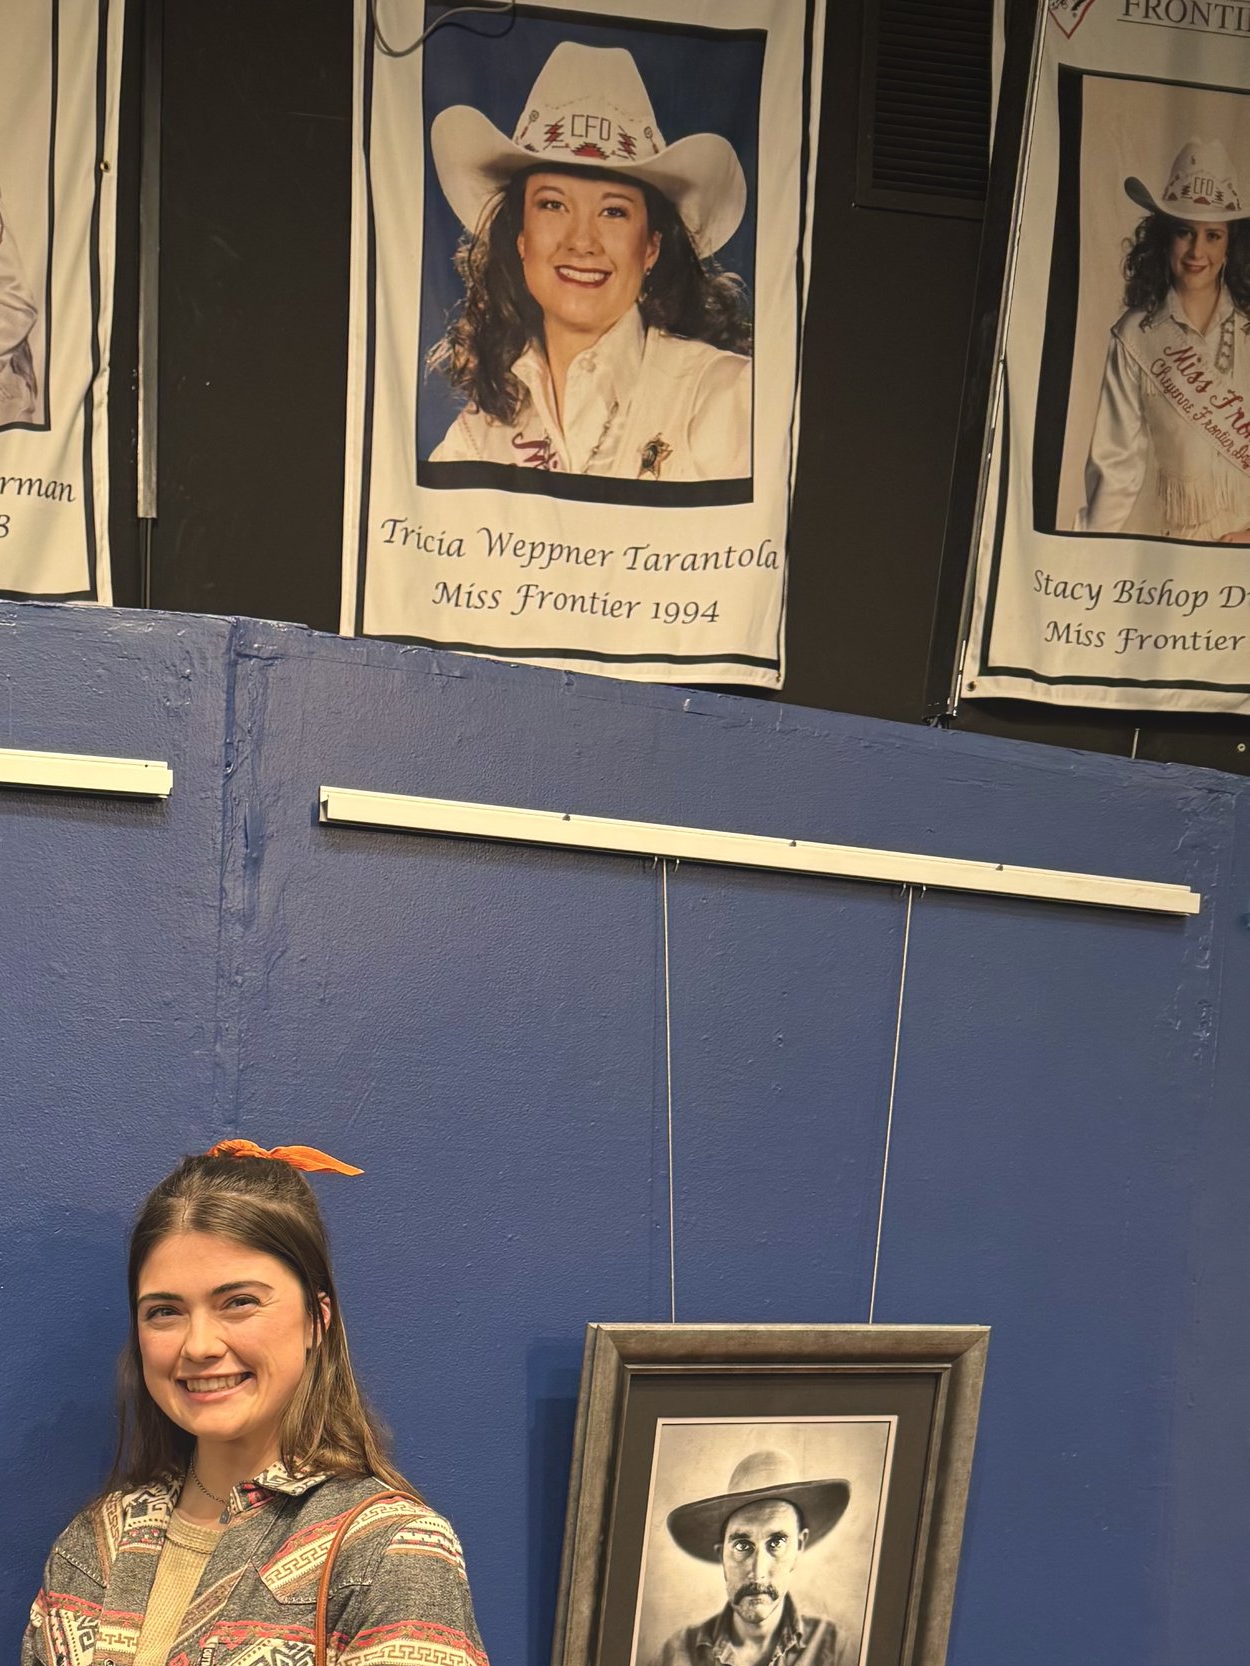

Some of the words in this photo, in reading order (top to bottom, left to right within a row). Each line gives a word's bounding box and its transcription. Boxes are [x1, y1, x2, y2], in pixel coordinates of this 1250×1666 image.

[1122, 0, 1250, 32] FRONTI
[1163, 346, 1213, 394] Miss
[1209, 389, 1250, 442] Fro
[380, 518, 466, 558] Tricia
[477, 527, 614, 569] Weppner
[623, 539, 780, 572] Tarantola
[432, 581, 502, 610] Miss
[510, 583, 641, 620] Frontier
[651, 600, 720, 624] 1994
[1033, 569, 1103, 611] Stacy
[1113, 579, 1209, 617] Bishop
[1219, 585, 1250, 608] D
[1044, 620, 1106, 648] Miss
[1115, 628, 1245, 654] Frontier
